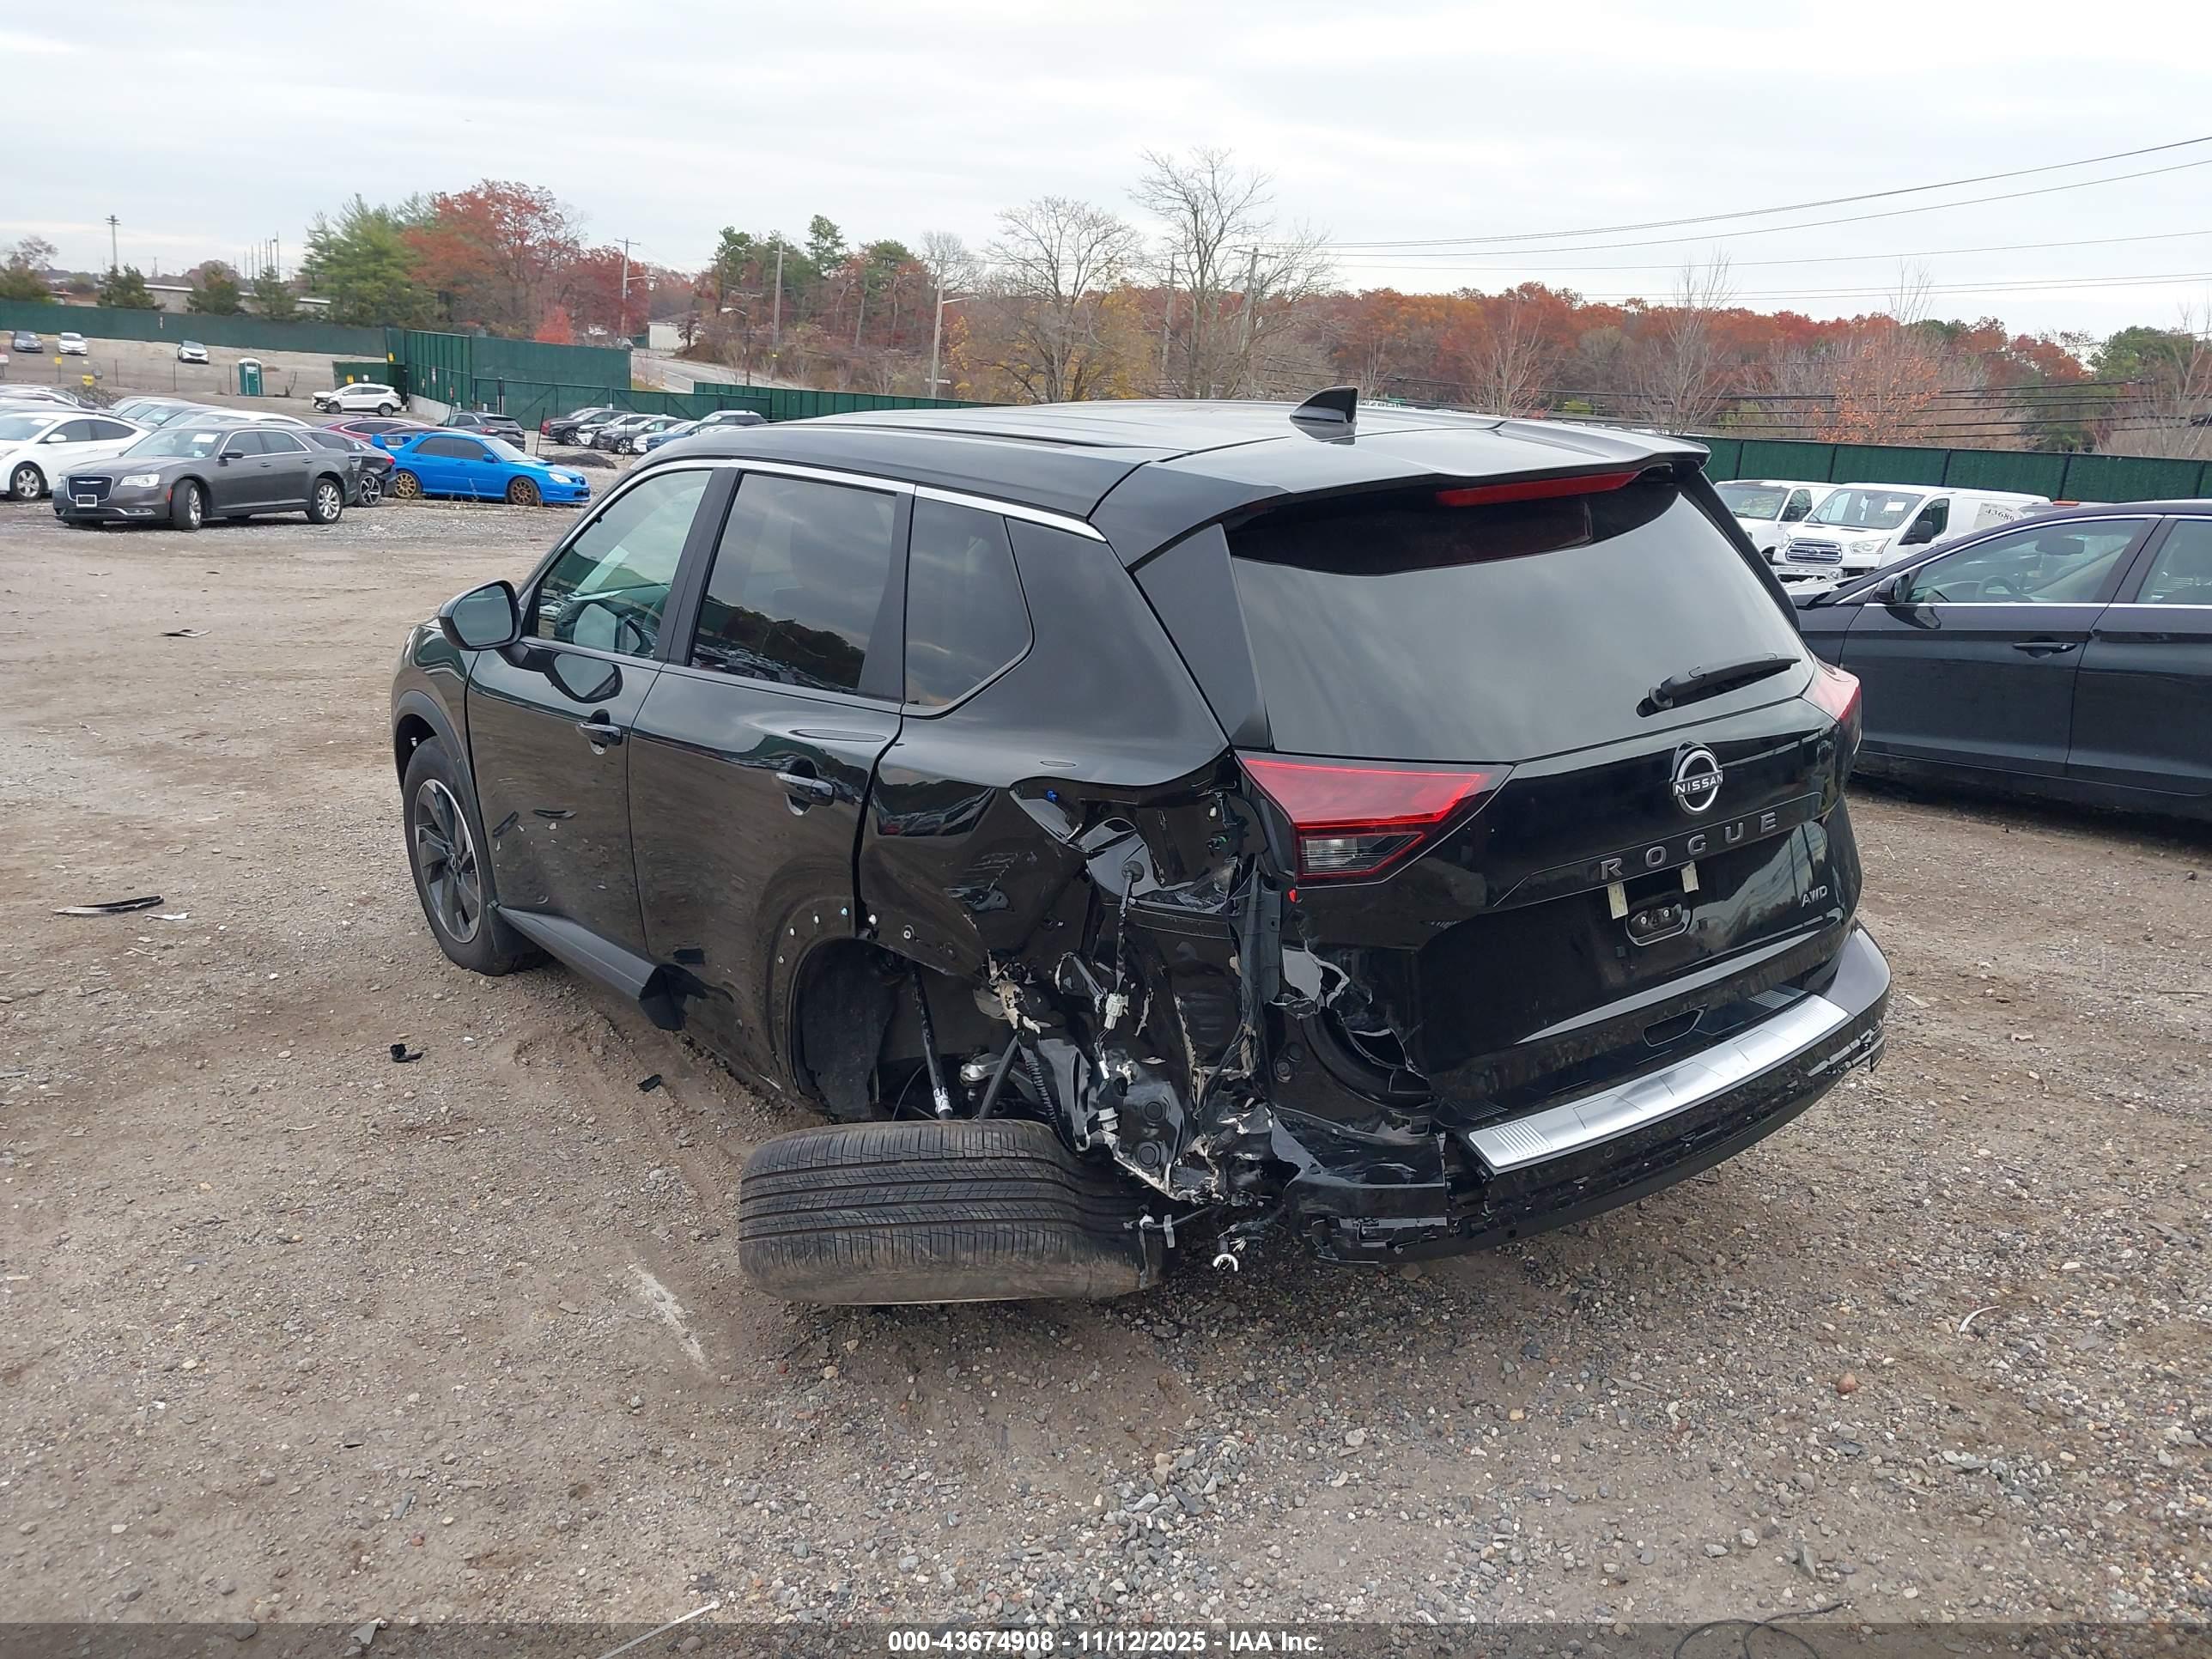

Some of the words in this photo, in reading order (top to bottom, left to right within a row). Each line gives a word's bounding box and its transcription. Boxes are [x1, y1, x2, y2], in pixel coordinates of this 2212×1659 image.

[1675, 774, 1723, 794] NISSAN
[1601, 811, 1777, 880] ROGUE
[1802, 885, 1828, 907] AWD
